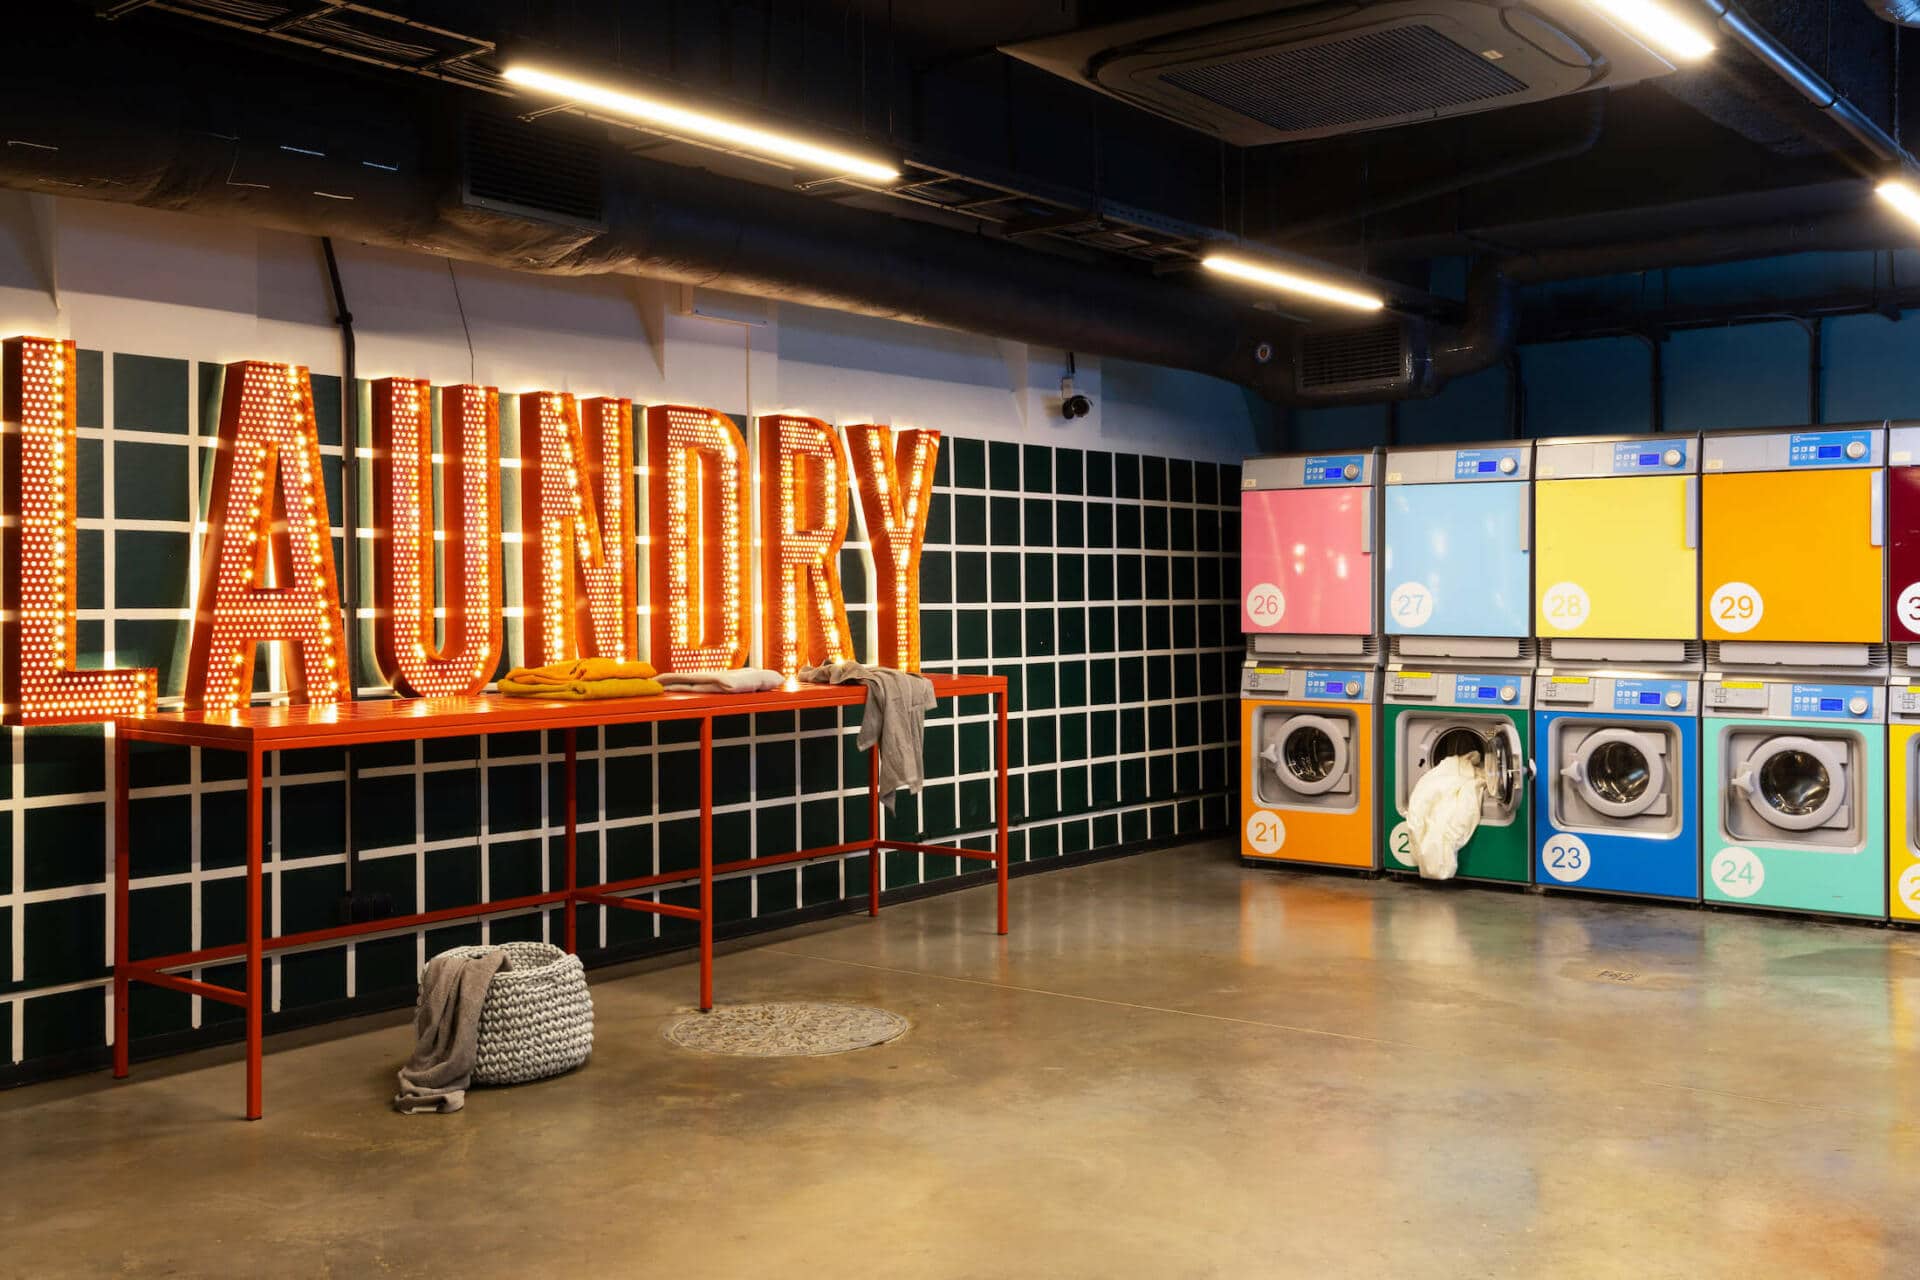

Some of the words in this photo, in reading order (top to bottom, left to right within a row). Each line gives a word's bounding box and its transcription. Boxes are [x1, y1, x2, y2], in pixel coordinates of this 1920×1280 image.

[2, 336, 941, 726] LAUNDRY
[1253, 594, 1279, 615] 26
[1398, 594, 1425, 616] 27
[1551, 594, 1582, 618] 28
[1719, 595, 1754, 620] 29
[1909, 596, 1920, 620] 3
[1255, 822, 1278, 843] 21
[1398, 833, 1411, 853] 2
[1551, 846, 1582, 869] 23
[1720, 860, 1755, 885] 24
[1909, 876, 1920, 900] 2
